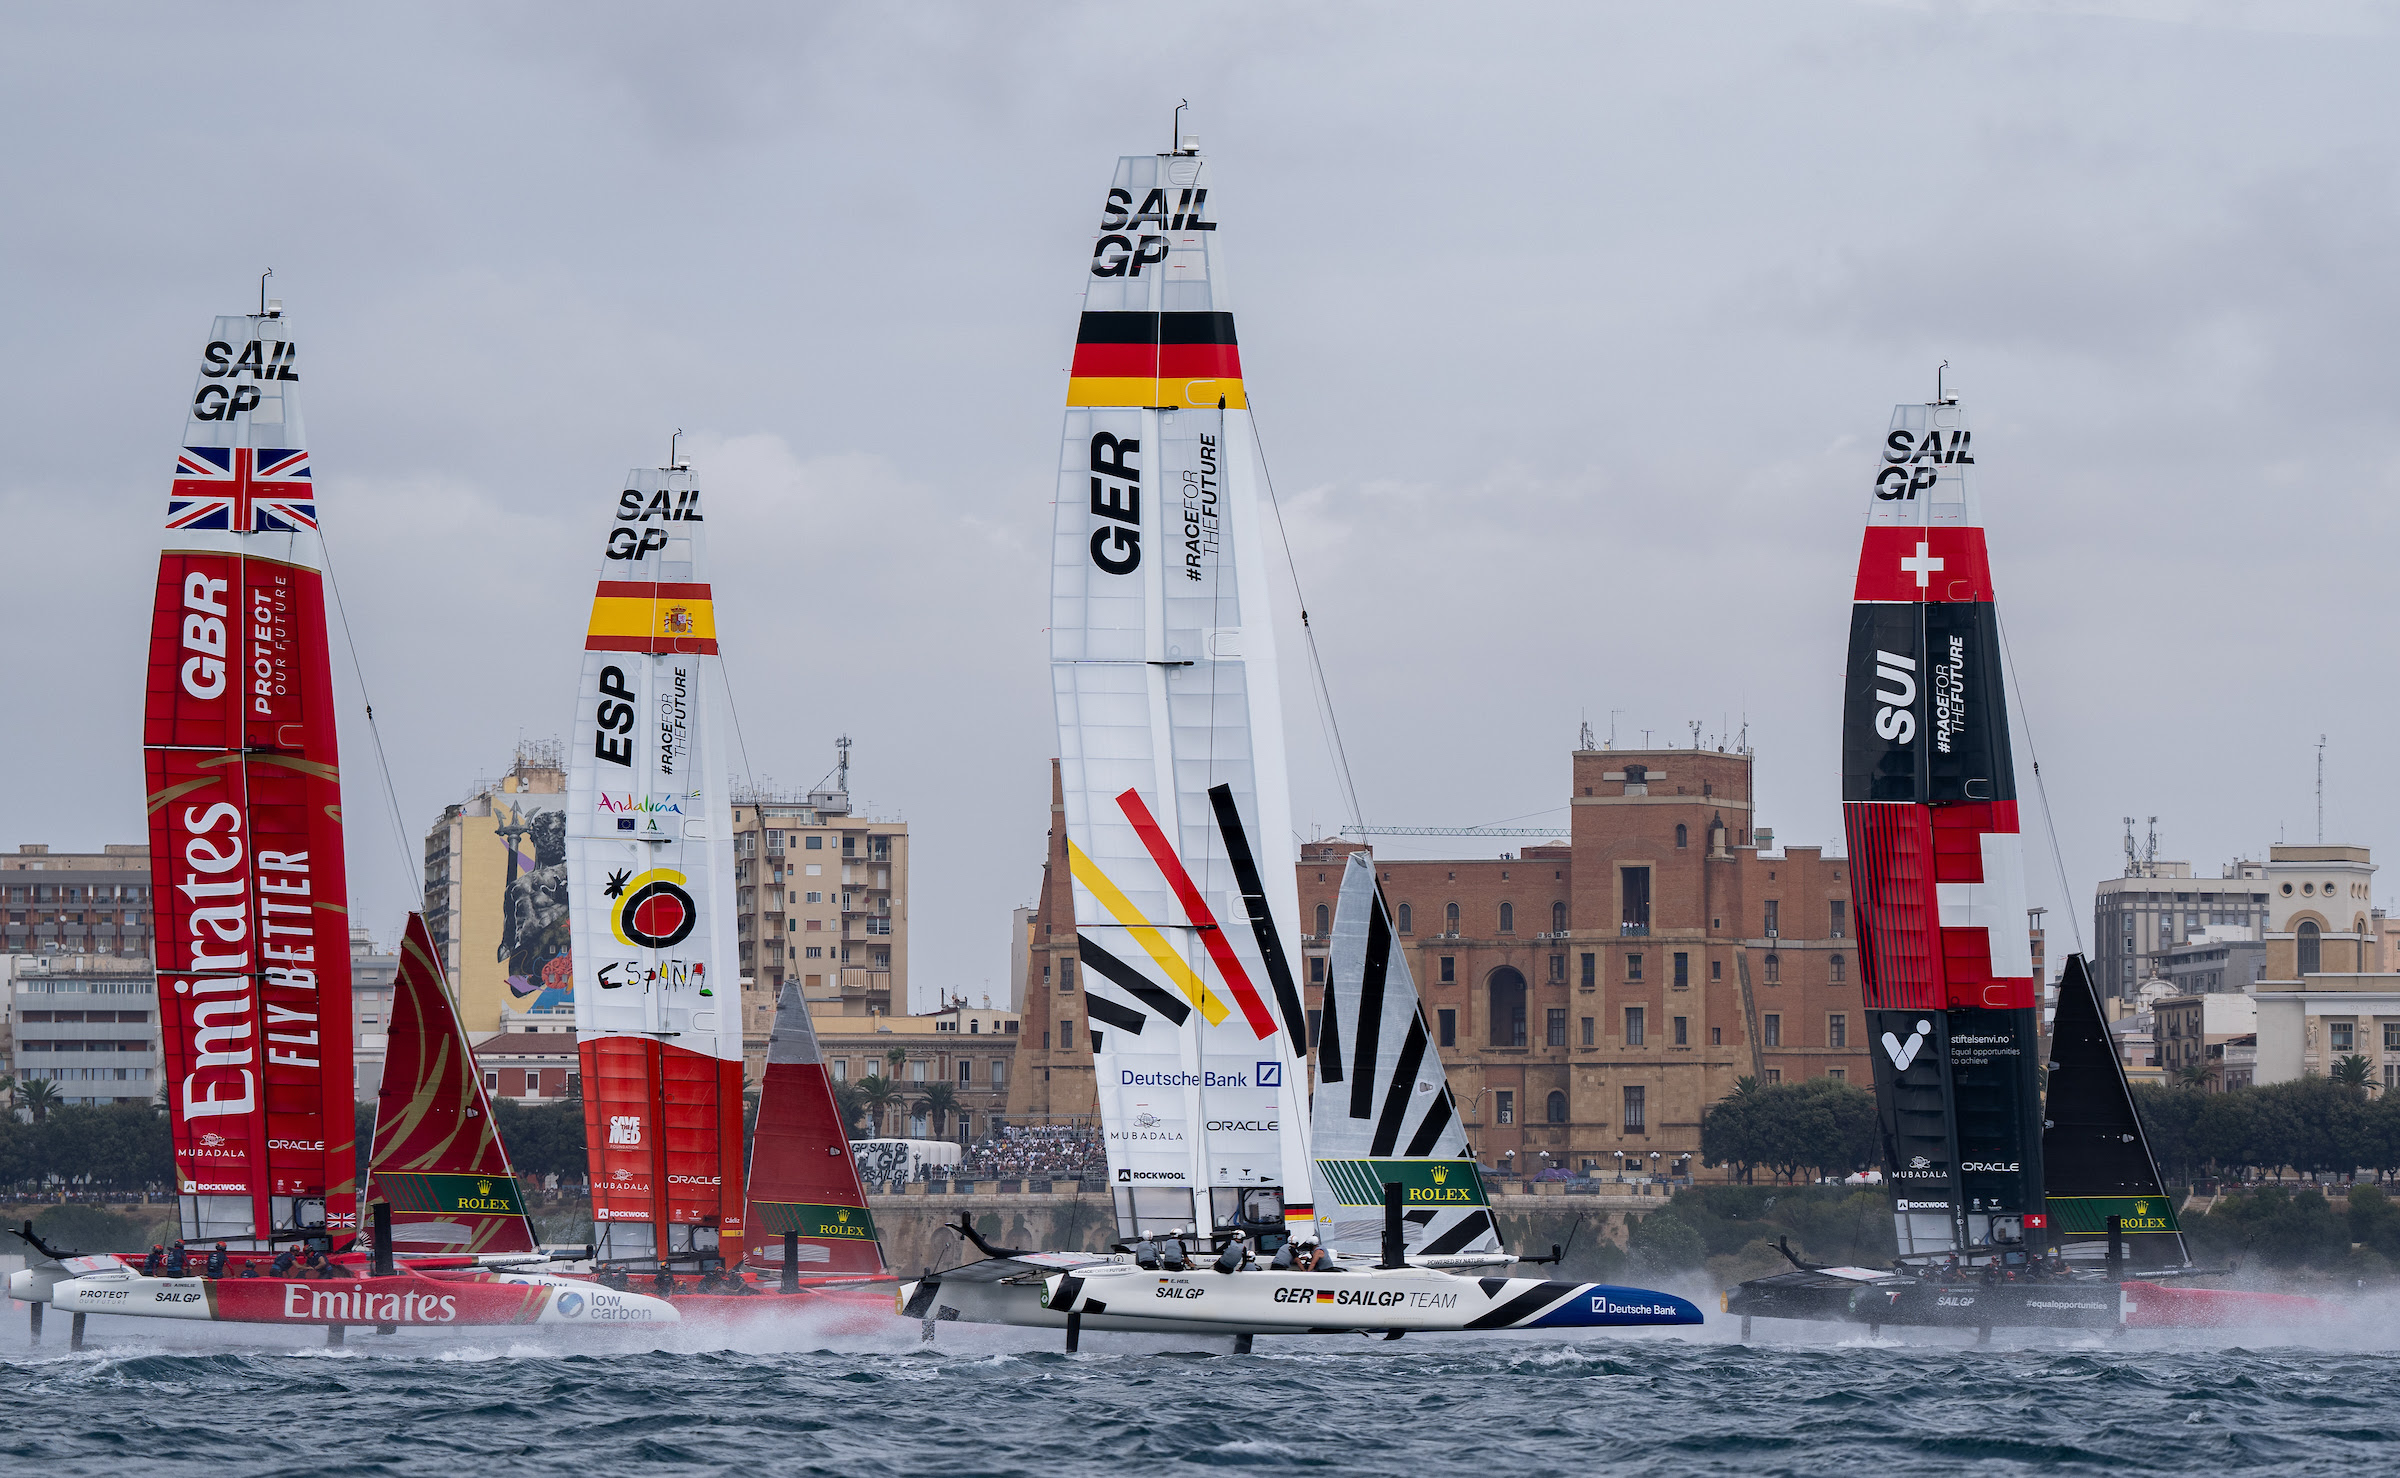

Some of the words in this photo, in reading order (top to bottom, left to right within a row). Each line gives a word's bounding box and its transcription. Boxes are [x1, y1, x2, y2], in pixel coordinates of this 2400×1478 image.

[1100, 188, 1217, 231] SAIL
[1091, 234, 1170, 278] GP
[200, 340, 299, 382] SAIL
[192, 384, 262, 421] GP
[1882, 430, 1975, 465] SAIL
[1873, 466, 1938, 501] GP
[615, 489, 704, 522] SAIL
[1090, 430, 1142, 576] GER
[1202, 433, 1218, 557] THEFUTURE
[1182, 470, 1201, 582] #RACEFOR
[605, 527, 669, 561] GP
[274, 575, 288, 651] FUTURE
[181, 571, 228, 701] GBR
[254, 588, 273, 715] PROTECT
[274, 655, 287, 697] OUR
[1950, 635, 1965, 733] THEFUTURE
[1875, 650, 1916, 745] SUI
[1935, 663, 1951, 754] #RACEFOR
[595, 664, 636, 768] ESP
[674, 666, 687, 758] THEFUTURE
[661, 692, 673, 776] #RACEFOR
[258, 850, 316, 991] BETTER
[175, 801, 256, 1123] Emirates
[598, 957, 713, 997] ESPAÑA
[266, 1003, 321, 1068] FLY
[1951, 1034, 2010, 1044] stiftelsenvi.no
[1951, 1048, 1972, 1057] Equal
[1973, 1048, 2020, 1057] opportunities
[1960, 1057, 1988, 1065] achieve
[1122, 1070, 1200, 1086] Deutsche
[1205, 1072, 1247, 1087] Bank
[610, 1116, 640, 1131] SAVE
[1206, 1121, 1279, 1131] ORACLE
[267, 1139, 324, 1151] ORACLE
[609, 1129, 641, 1145] MED
[1110, 1131, 1183, 1140] MUBADALA
[178, 1149, 245, 1158] MUBADALA
[877, 1151, 907, 1170] GP
[1133, 1172, 1185, 1180] ROCKWOOL
[1961, 1162, 2020, 1171] ORACLE
[197, 1183, 246, 1191] ROCKWOOL
[594, 1182, 650, 1190] MUBADALA
[667, 1175, 721, 1185] ORACLE
[457, 1198, 510, 1210] ROLEX
[1409, 1188, 1470, 1201] ROLEX
[610, 1210, 649, 1218] ROCKWOOL
[2120, 1218, 2166, 1228] ROLEX
[820, 1224, 865, 1236] ROLEX
[80, 1290, 130, 1299] PROTECT
[283, 1283, 456, 1321] Emirates
[591, 1292, 621, 1306] low
[1273, 1287, 1314, 1304] GER
[1409, 1292, 1457, 1309] TEAM
[2026, 1300, 2108, 1310] #equalopportunities
[591, 1305, 652, 1320] carbon
[1609, 1303, 1652, 1315] Deutsche
[1653, 1305, 1677, 1316] Bank
